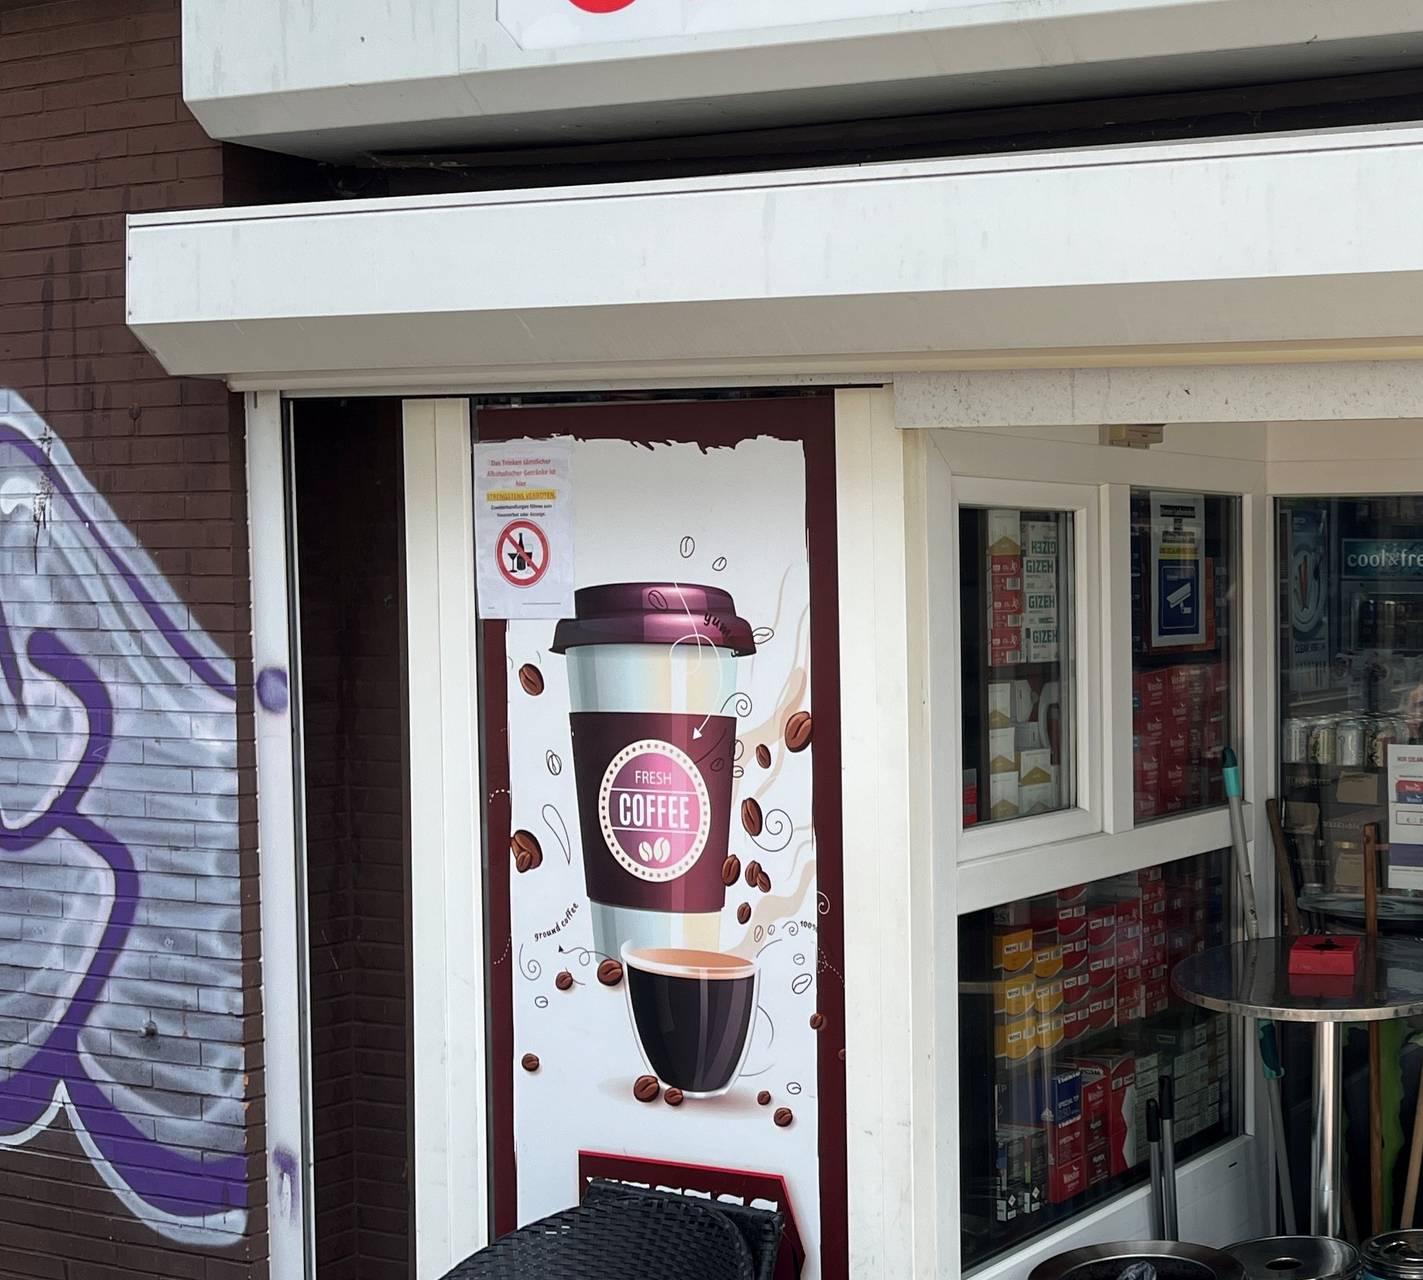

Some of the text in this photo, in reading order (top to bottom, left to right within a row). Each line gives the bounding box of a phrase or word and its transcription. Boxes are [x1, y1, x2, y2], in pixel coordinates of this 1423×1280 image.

[1026, 560, 1054, 574] GIZEH
[1028, 595, 1055, 609] GIZEH
[635, 770, 672, 785] FRESH
[619, 793, 690, 829] COFFEE
[534, 902, 579, 942] ground coffee
